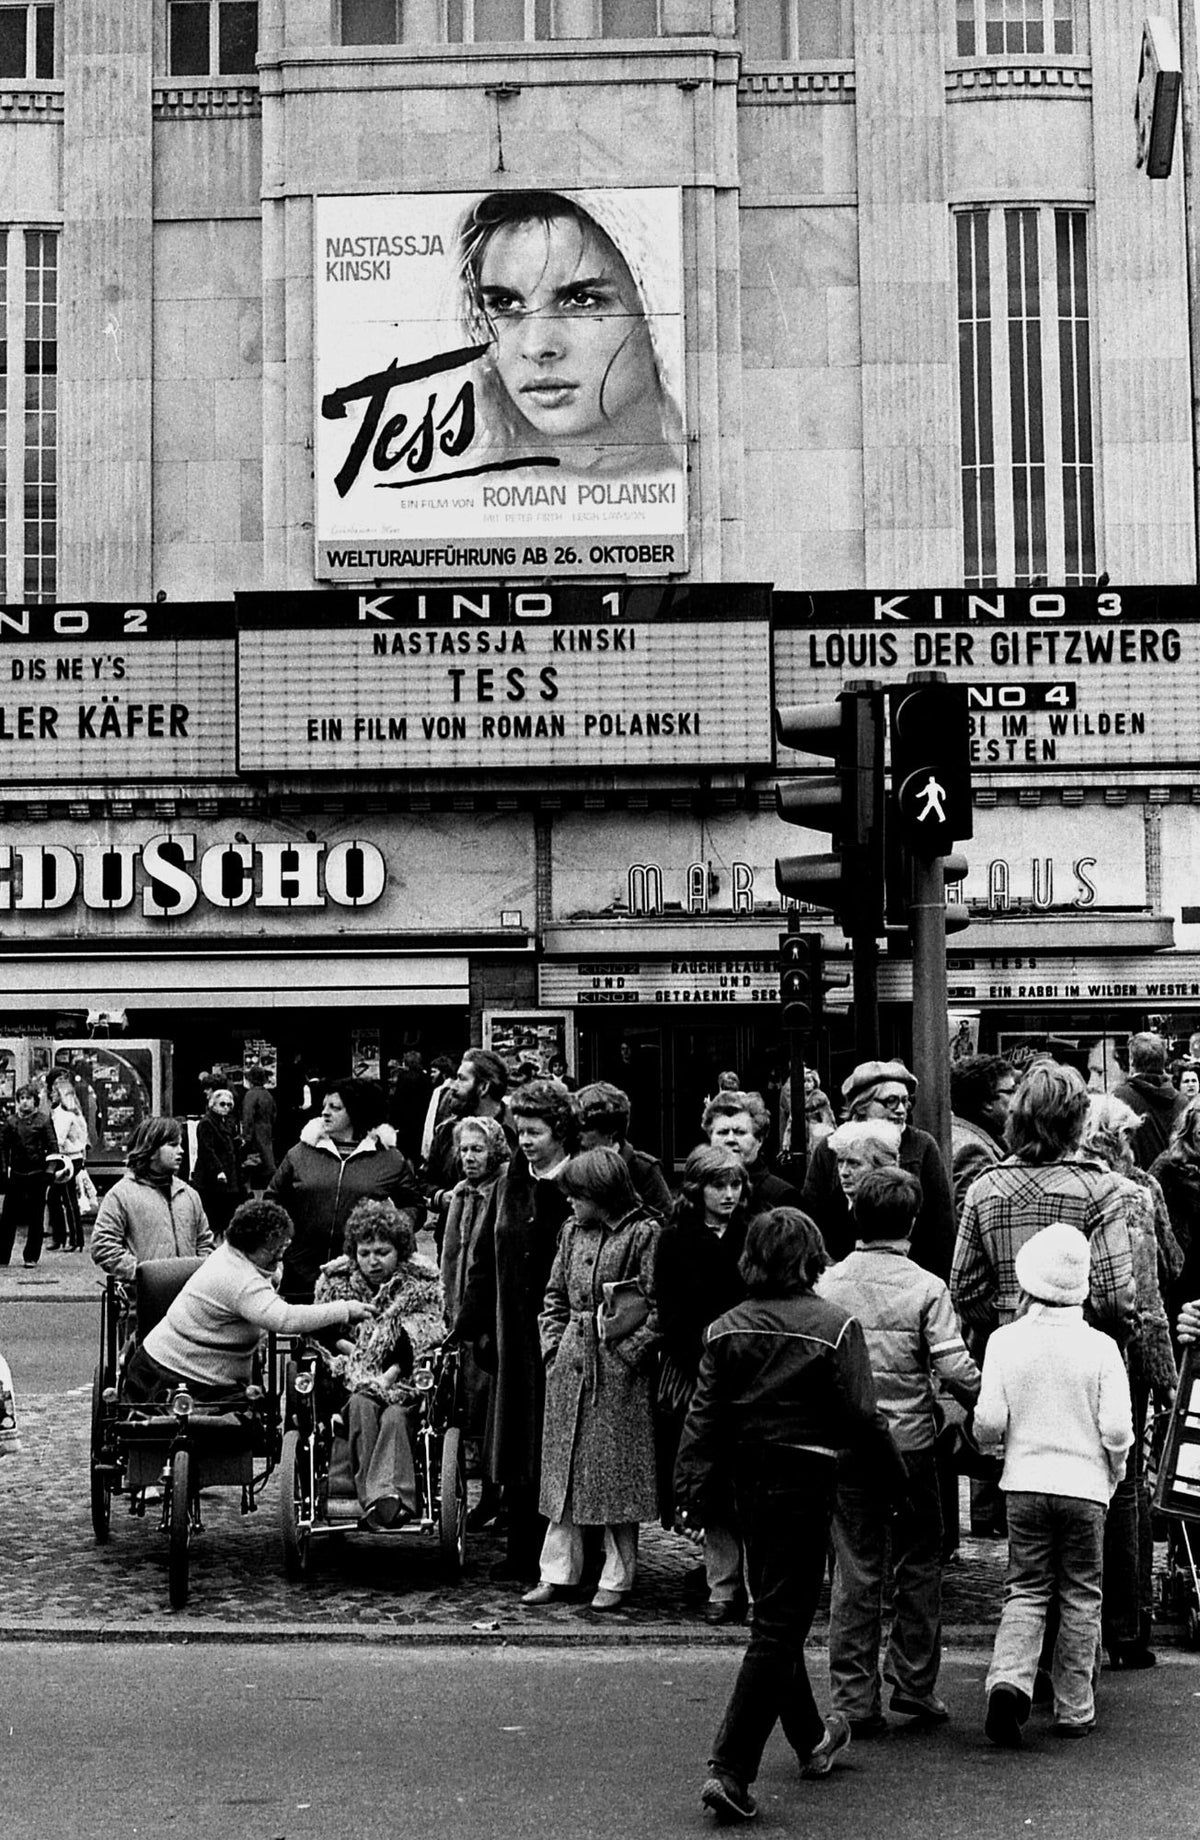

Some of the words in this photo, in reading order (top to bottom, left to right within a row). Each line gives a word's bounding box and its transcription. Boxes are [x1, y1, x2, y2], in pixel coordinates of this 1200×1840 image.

[326, 235, 444, 258] NASTASSJA
[326, 261, 390, 282] KINSKI
[321, 341, 491, 498] Tess
[401, 500, 418, 509] EIN
[421, 500, 448, 508] FILM
[453, 499, 474, 508] VON
[483, 486, 566, 507] ROMAN
[578, 483, 676, 504] POLANSKI
[327, 544, 516, 568] WELTURAUFFÜHRUNG
[522, 547, 547, 565] AB
[554, 547, 583, 564] 26.
[589, 545, 675, 563] OKTOBER
[358, 593, 552, 621] KINO
[602, 592, 620, 617] 1
[874, 594, 1066, 620] KINO
[1097, 592, 1122, 617] 3
[123, 609, 148, 633] 2
[373, 630, 526, 656] NASTASSJA
[553, 628, 636, 652] KINSKI
[809, 632, 897, 668] LOUIS
[914, 632, 974, 667] DER
[990, 629, 1182, 666] GIFTZWERG
[448, 667, 559, 702] TESS
[1045, 685, 1070, 706] 4
[77, 695, 190, 740] KÄFER
[307, 718, 342, 742] EIN
[354, 717, 406, 741] FILM
[422, 716, 466, 740] VON
[482, 715, 565, 739] ROMAN
[584, 712, 700, 737] POLANSKI
[1002, 715, 1027, 736] IM
[1049, 712, 1145, 735] WILDEN
[990, 958, 1037, 970] TESS
[592, 977, 625, 989] UND
[719, 976, 750, 988] UND
[990, 987, 1012, 998] EIN
[1019, 986, 1058, 998] RABBI
[1065, 986, 1080, 998] IM
[1088, 985, 1138, 997] WILDEN
[1147, 984, 1200, 997] WESTEN
[655, 990, 736, 1003] GETRAENKE
